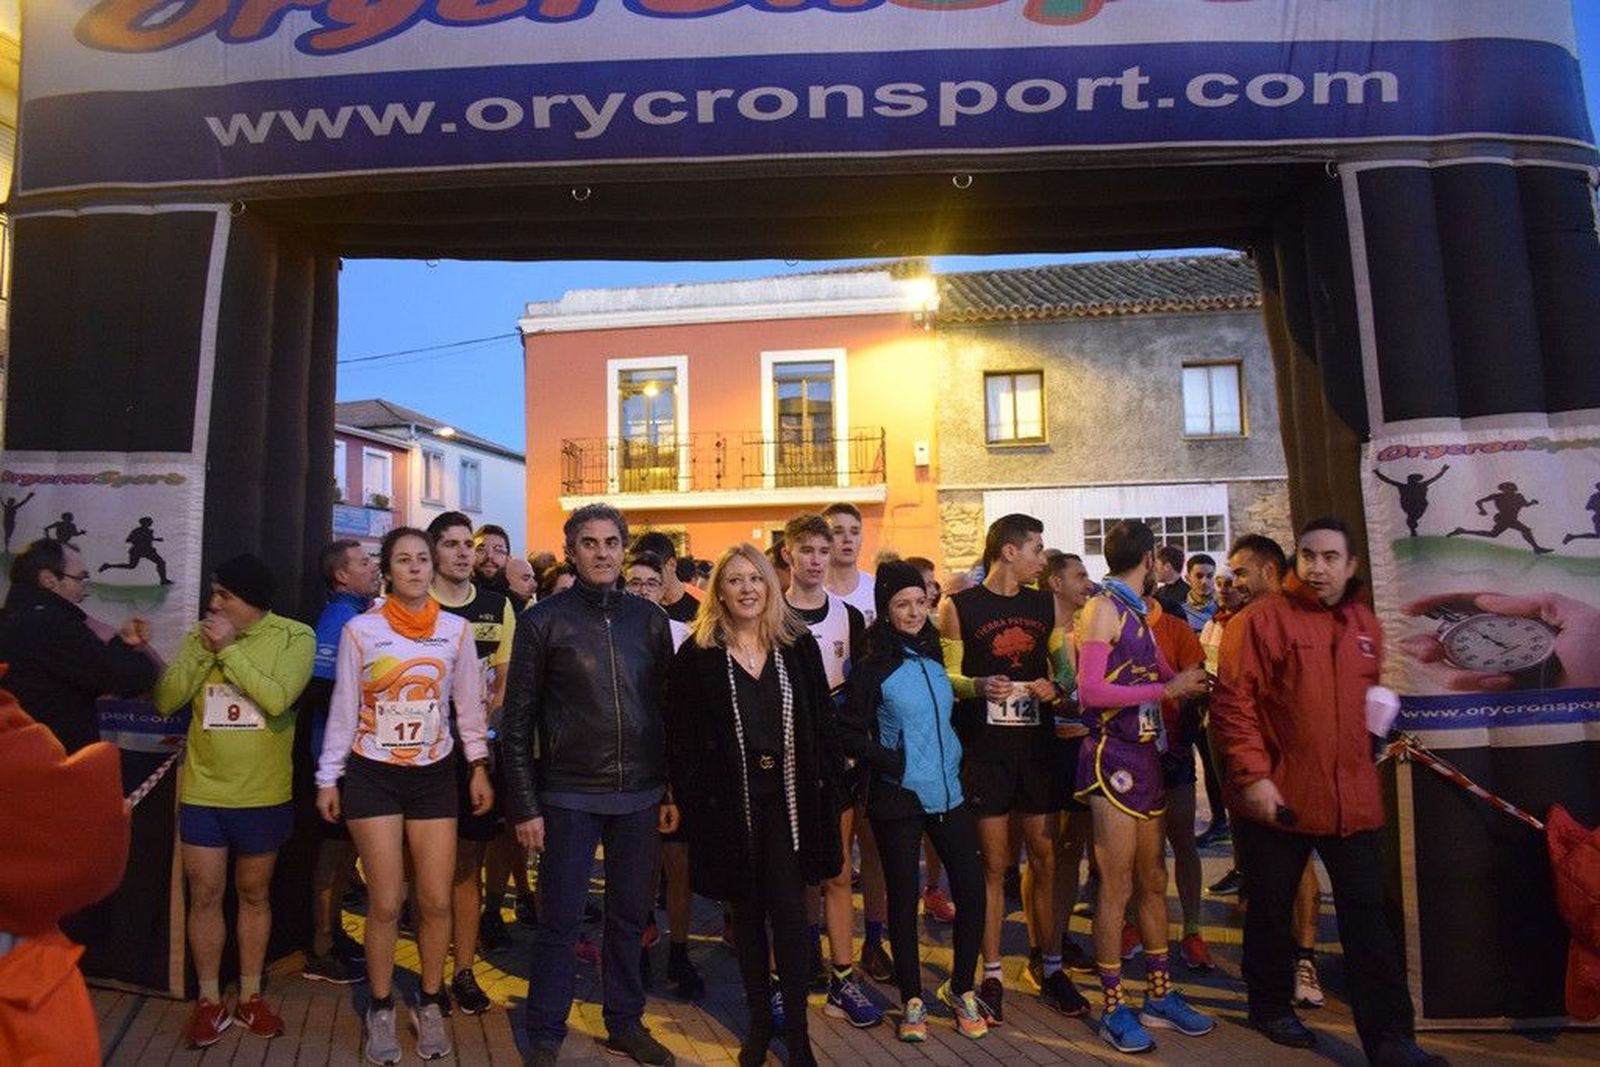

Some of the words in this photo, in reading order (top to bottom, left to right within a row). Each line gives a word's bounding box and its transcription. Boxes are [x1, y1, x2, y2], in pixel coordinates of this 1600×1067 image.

[205, 65, 1399, 148] www.orycronsport.com
[227, 704, 240, 721] 9
[999, 700, 1037, 718] 112
[394, 722, 422, 740] 17
